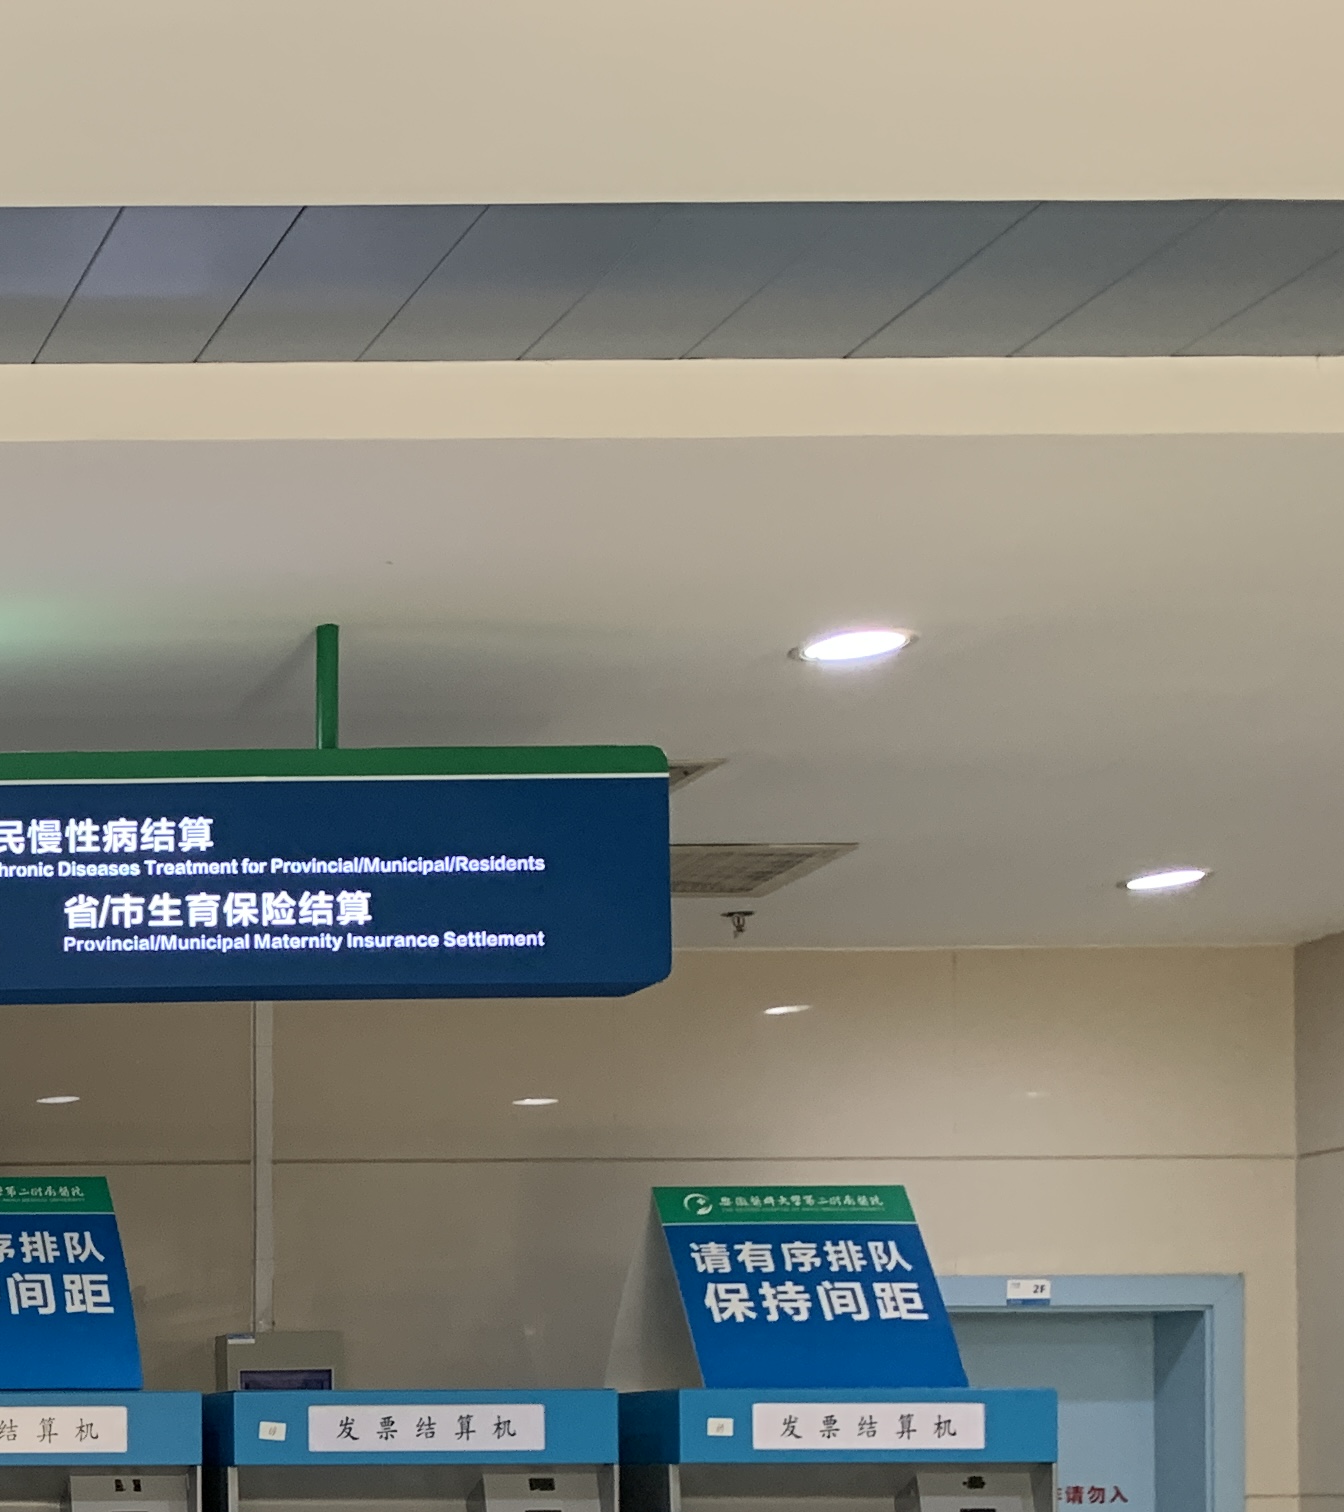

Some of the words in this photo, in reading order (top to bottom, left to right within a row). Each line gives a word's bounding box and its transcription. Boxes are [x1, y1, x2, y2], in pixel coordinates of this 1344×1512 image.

[57, 860, 141, 877] Diseases
[143, 858, 239, 876] Treatment
[240, 857, 268, 874] for
[270, 854, 546, 876] Provincial/Municipal/Residents
[63, 889, 373, 930] 省/市生育保险结算
[63, 933, 250, 953] Provincial/Municipal
[253, 932, 344, 952] Maternity
[346, 932, 440, 949] Insurance
[443, 930, 546, 948] Settlement
[689, 1240, 913, 1274] 请有序排队
[704, 1280, 929, 1323] 保持间距
[1033, 1285, 1045, 1293] 2F
[336, 1414, 517, 1441] 发票结算机
[780, 1413, 957, 1441] 发票结算机
